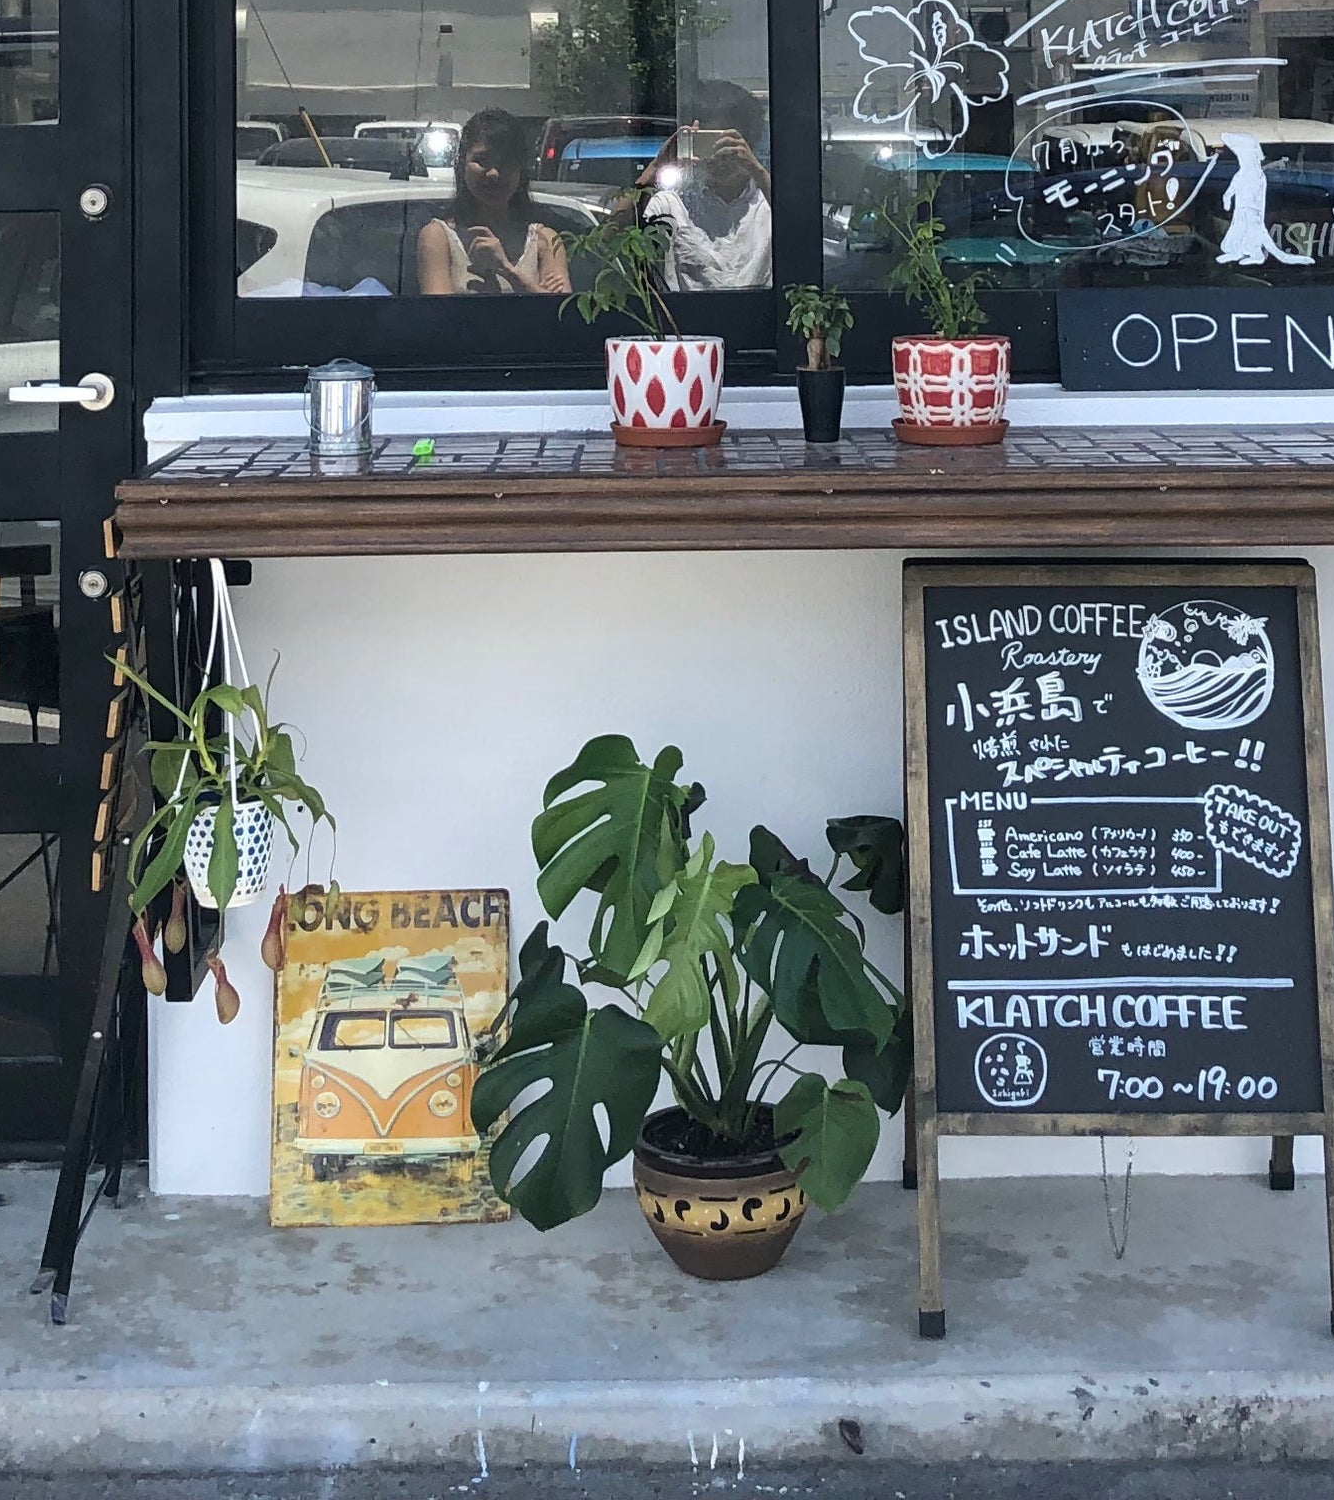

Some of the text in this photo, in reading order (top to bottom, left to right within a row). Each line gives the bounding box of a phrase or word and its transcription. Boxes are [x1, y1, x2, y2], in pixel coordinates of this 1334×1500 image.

[935, 603, 1147, 649] ISLAND COFFEE
[1000, 641, 1102, 674] Roastery
[960, 790, 1029, 812] MENU
[1214, 794, 1292, 839] TAKE OUT
[1005, 826, 1084, 843] Americano
[1006, 843, 1042, 860] Cafe
[1046, 843, 1088, 859] Latte
[1007, 862, 1036, 882] Soy
[1043, 861, 1083, 877] Latte
[289, 893, 505, 933] ONG BEACH
[957, 994, 1249, 1030] KLATCH COFFEE
[1088, 1036, 1167, 1057] 営業時間
